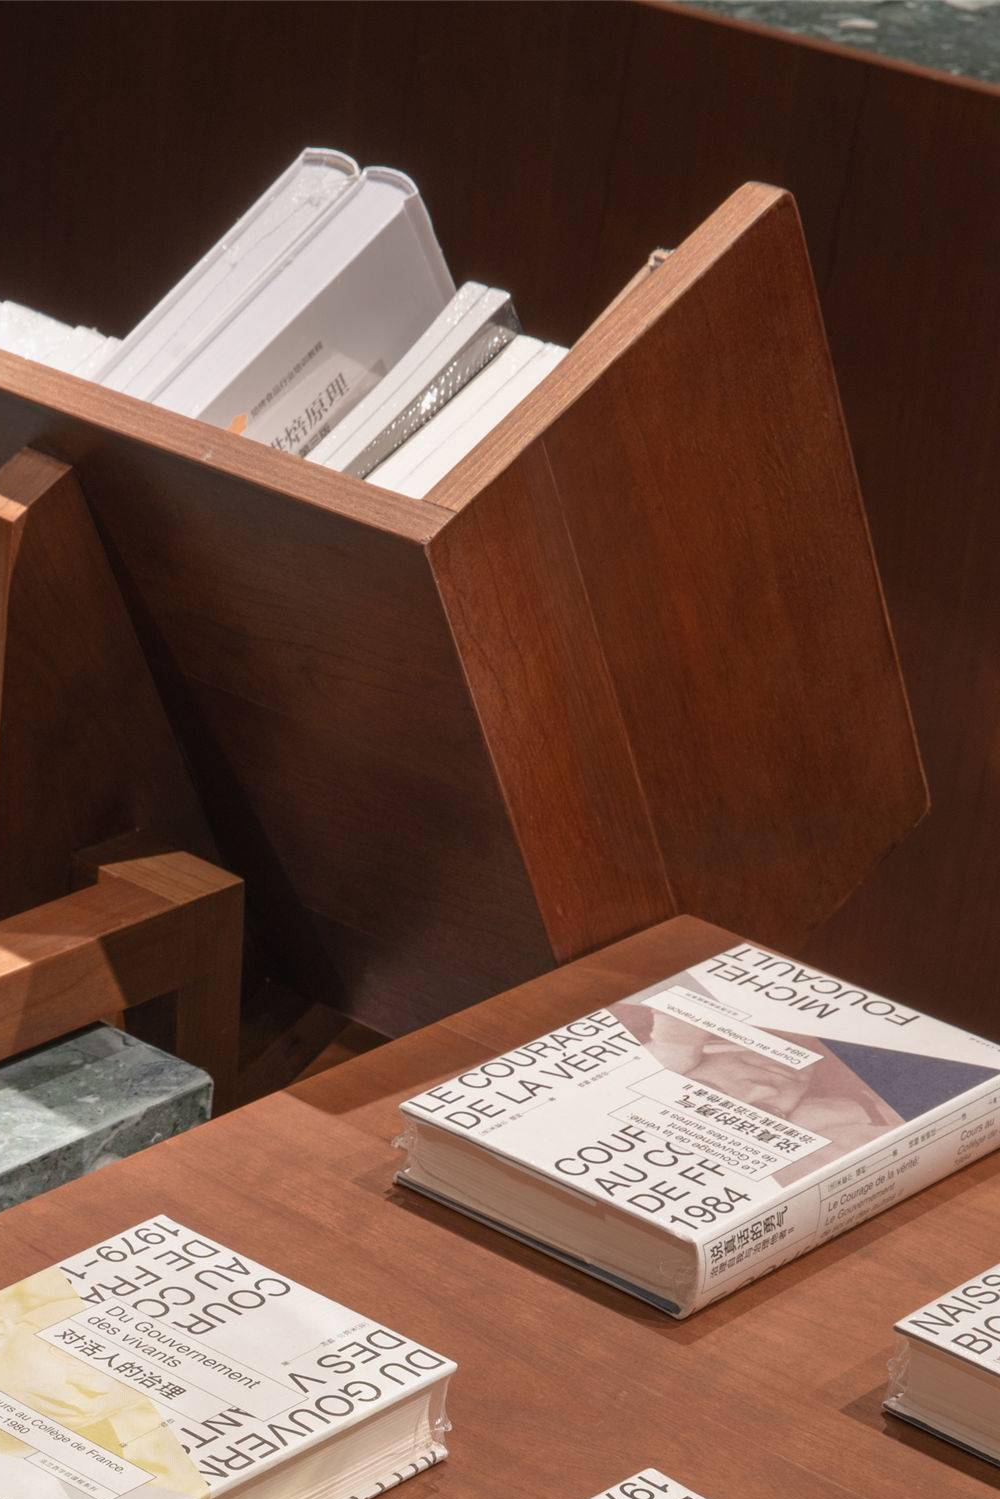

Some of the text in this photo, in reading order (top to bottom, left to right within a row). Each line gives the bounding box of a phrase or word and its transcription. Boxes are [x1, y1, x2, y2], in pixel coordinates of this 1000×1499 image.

[705, 958, 840, 1019] MICHEL
[723, 948, 921, 1026] FOUCAULT
[408, 1011, 620, 1113] LE COURAGE
[445, 1099, 506, 1129] DE
[496, 1080, 552, 1104] LA
[670, 1114, 706, 1130] autres
[676, 1095, 800, 1153] 说真话的勇气
[693, 1089, 815, 1143] 治理自我与治理他者
[662, 1129, 674, 1137] la
[667, 1123, 767, 1169] Le Gouvernement
[675, 1135, 691, 1143] de
[691, 1142, 745, 1166] Courage
[706, 1130, 728, 1140] des
[740, 1146, 761, 1155] soi
[595, 1164, 647, 1196] AU
[741, 1165, 758, 1174] Le
[761, 1154, 777, 1162] de
[627, 1181, 690, 1213] DE
[671, 1187, 750, 1229] 1984
[154, 1239, 220, 1271] DE
[711, 1206, 787, 1263] 说真话的勇气
[132, 1257, 250, 1318] AU CO
[172, 1278, 290, 1334] COUR
[55, 1329, 186, 1399] 对活人的治理
[87, 1317, 181, 1367] des vivants
[105, 1306, 260, 1388] Du Gouvernement
[317, 1330, 406, 1374] DES
[379, 1349, 445, 1385] DU
[15, 1412, 31, 1421] au
[31, 1419, 70, 1442] Collège
[70, 1442, 86, 1451] de
[85, 1449, 124, 1474] France,
